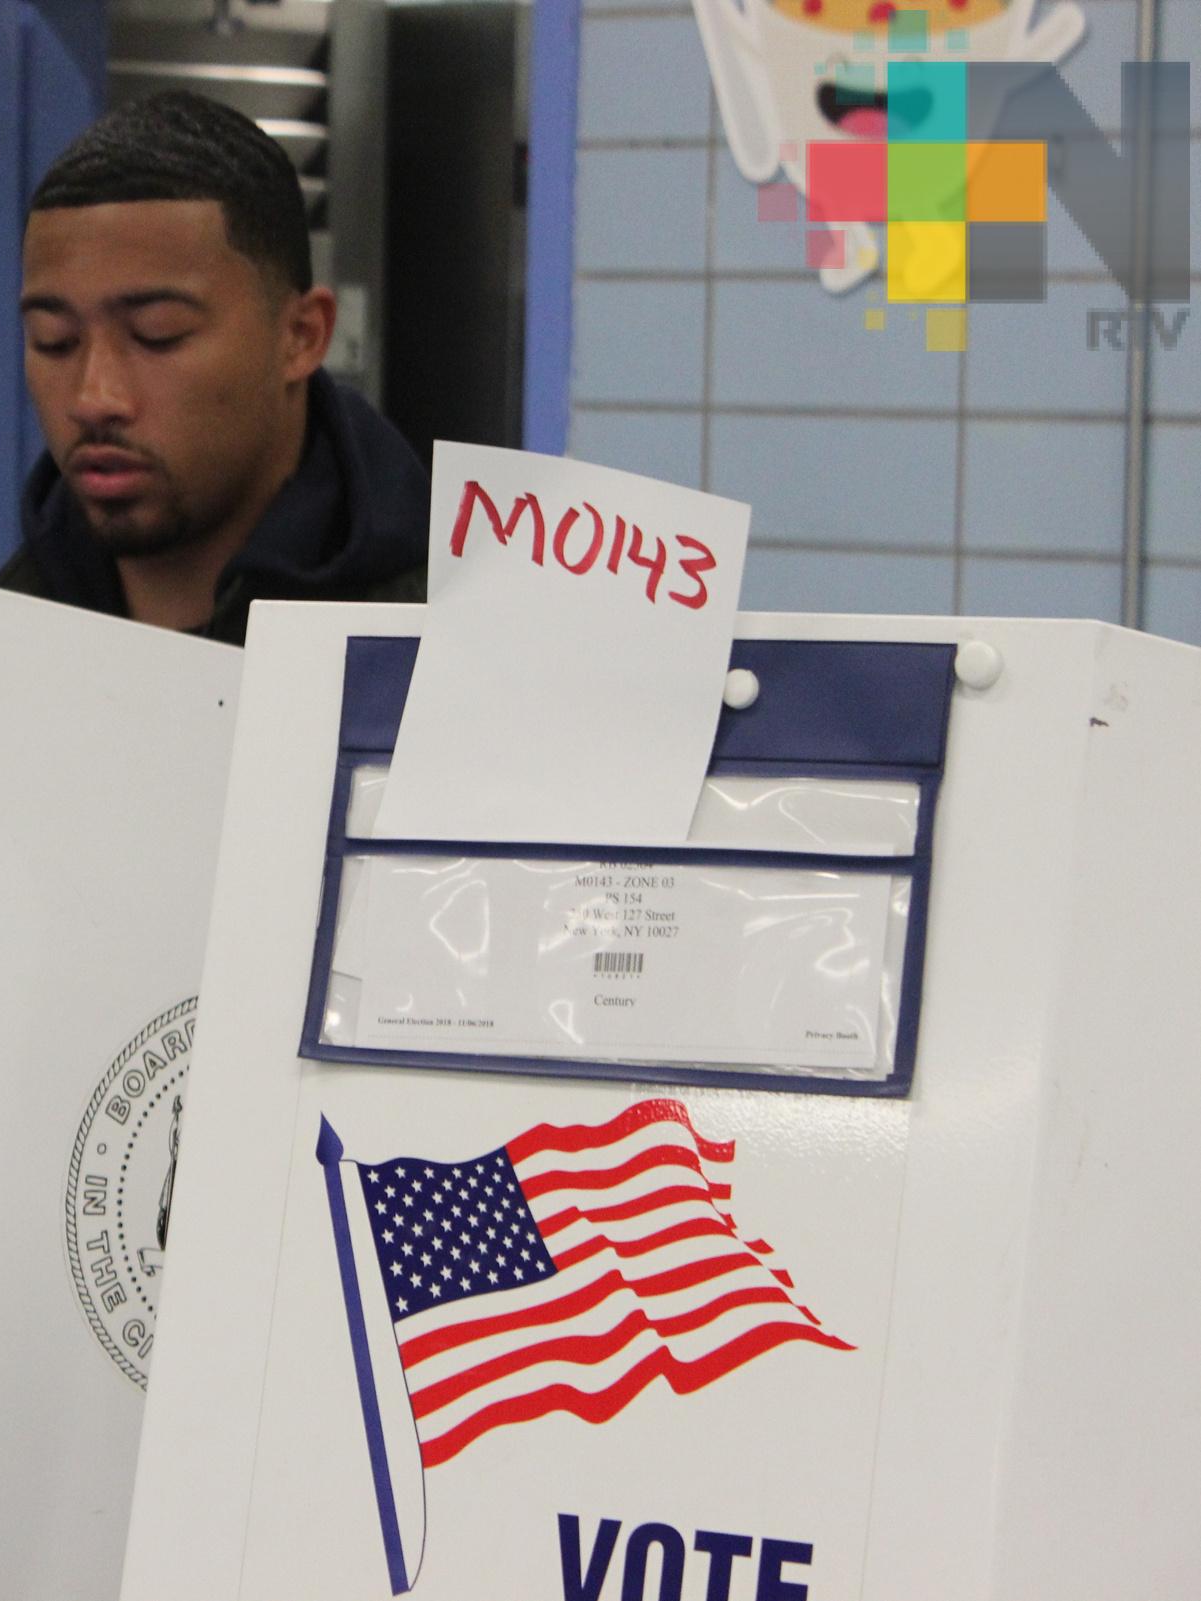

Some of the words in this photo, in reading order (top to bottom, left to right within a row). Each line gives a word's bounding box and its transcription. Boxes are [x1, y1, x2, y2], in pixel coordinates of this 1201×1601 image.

[450, 480, 717, 610] M0143
[575, 875, 613, 888] M0143
[623, 876, 659, 889] ZONE
[661, 876, 675, 889] 03
[605, 892, 620, 904] PS
[623, 892, 642, 904] 154
[623, 909, 642, 921] 127
[645, 909, 676, 921] Street
[624, 925, 643, 938] NY
[646, 926, 679, 938] 10027
[593, 993, 636, 1008] Century
[86, 1229, 128, 1314] THE
[557, 1512, 814, 1601] VOTE
